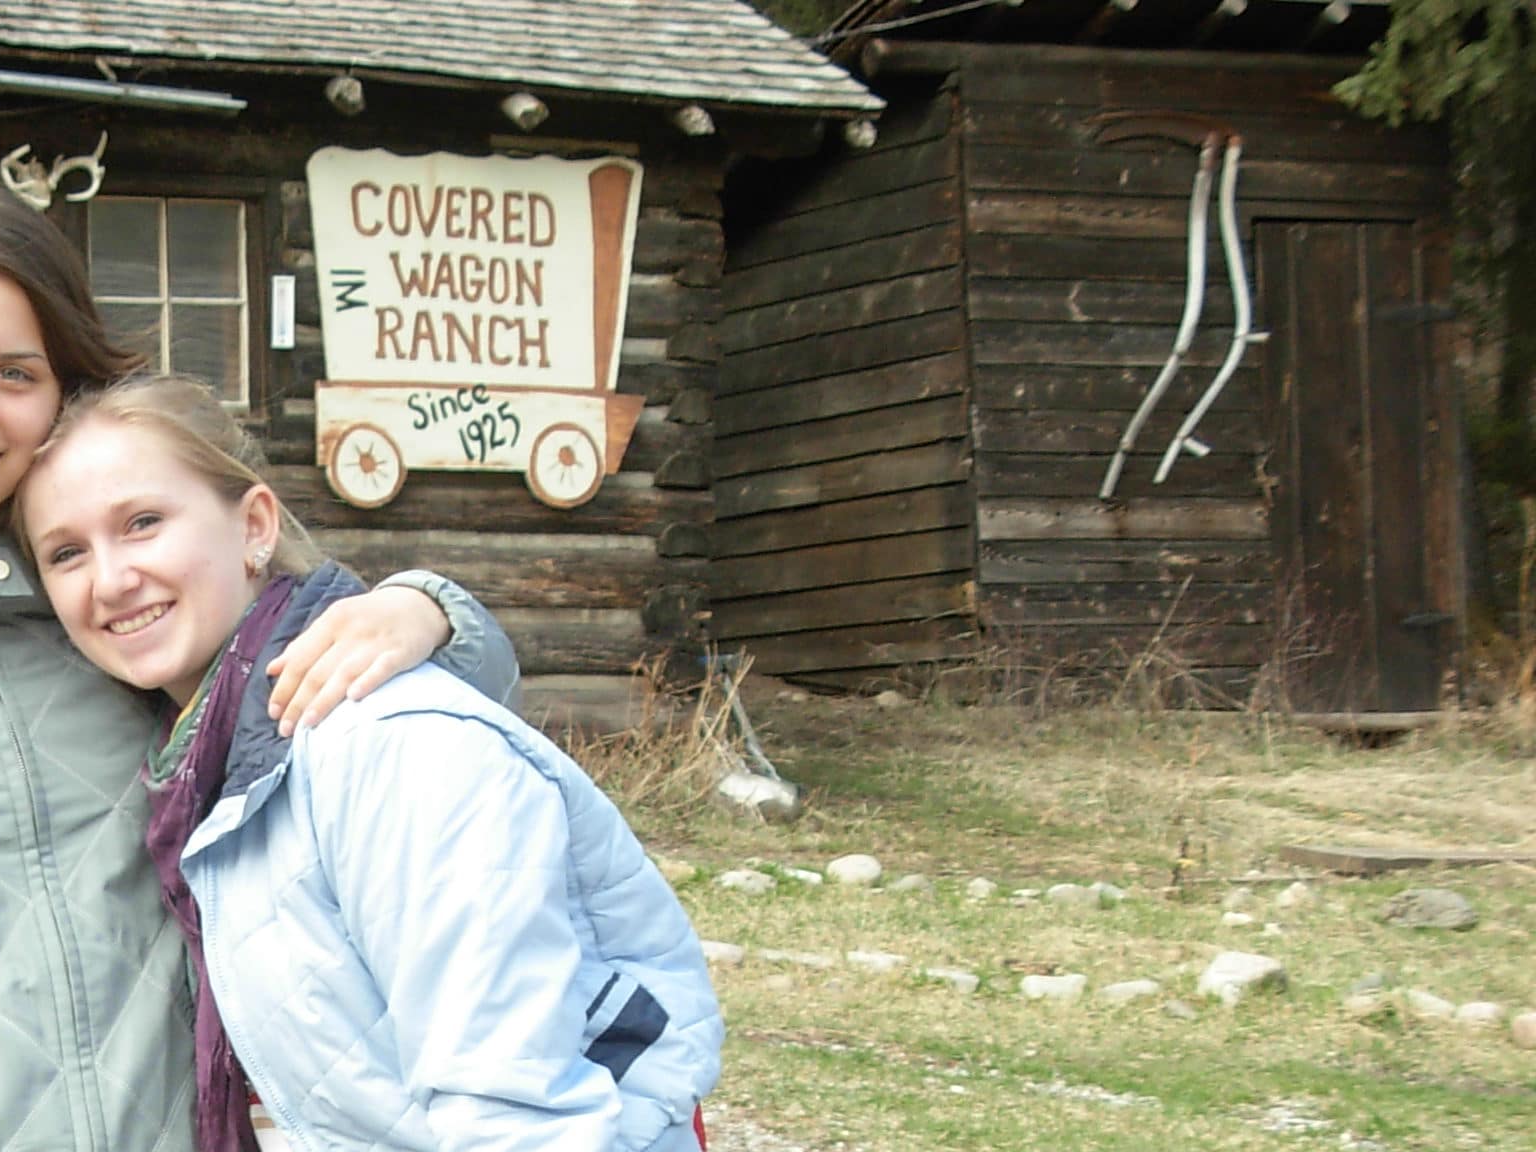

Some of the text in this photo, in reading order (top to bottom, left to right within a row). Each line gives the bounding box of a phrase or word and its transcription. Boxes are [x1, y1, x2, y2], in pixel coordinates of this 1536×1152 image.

[351, 181, 556, 247] COVERED
[390, 252, 543, 306] WAGON
[375, 307, 549, 368] RANCH
[408, 385, 488, 429] Since
[460, 404, 519, 462] 1925
